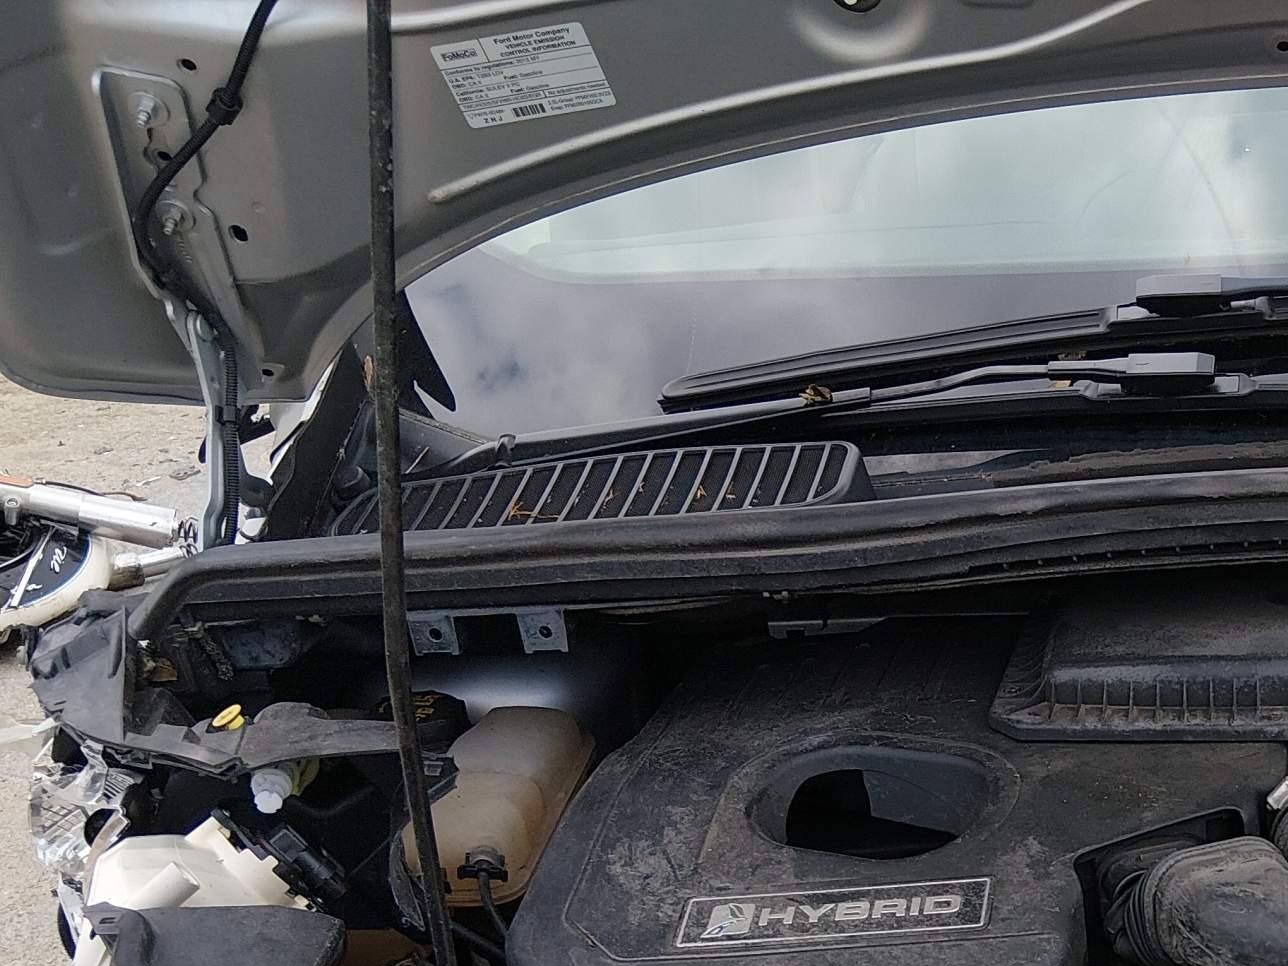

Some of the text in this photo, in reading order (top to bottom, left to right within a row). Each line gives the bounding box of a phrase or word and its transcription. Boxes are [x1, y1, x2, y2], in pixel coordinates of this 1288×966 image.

[493, 26, 570, 44] Ford Motor Company
[505, 35, 565, 49] VEHICLE EMISSION
[440, 48, 478, 61] FoMoCo
[499, 40, 576, 57] CONTROL INFORMATION
[758, 894, 961, 926] HYBRID
